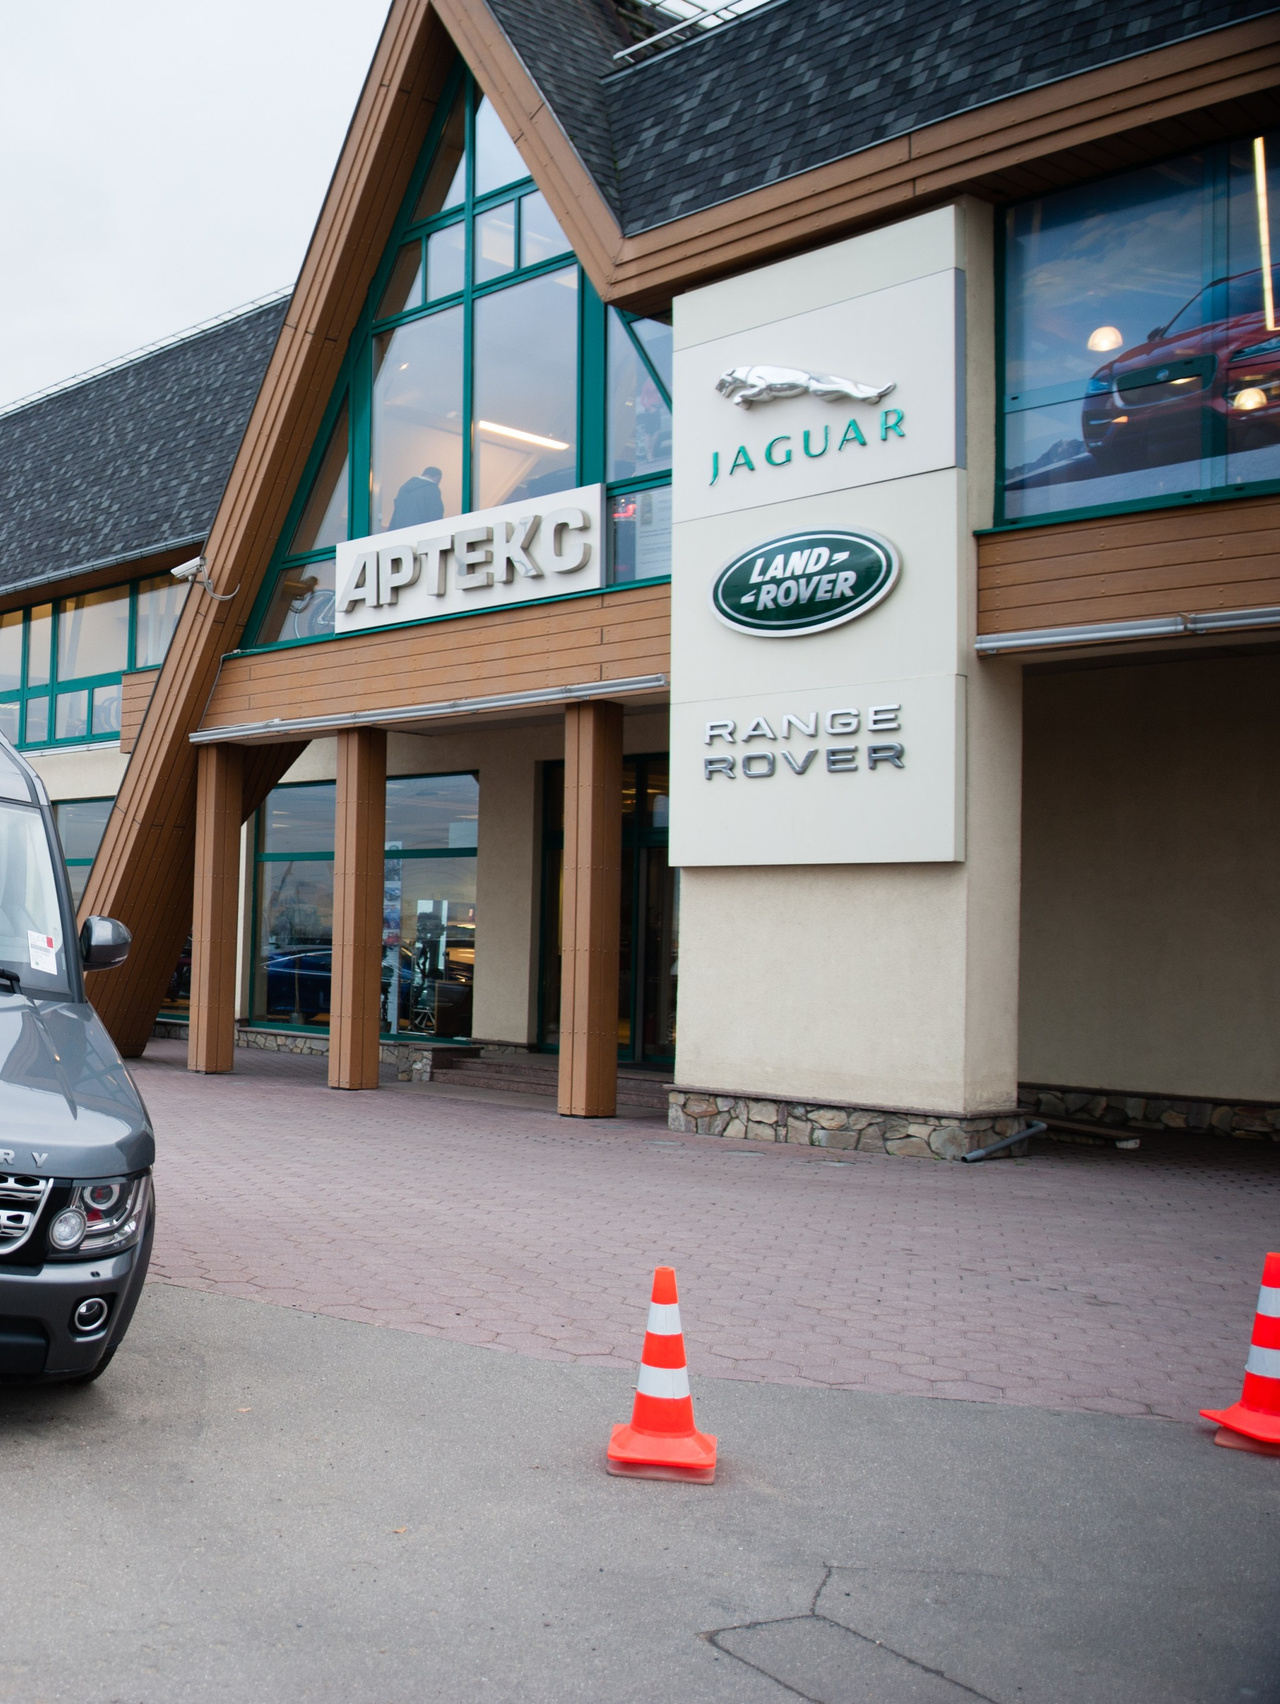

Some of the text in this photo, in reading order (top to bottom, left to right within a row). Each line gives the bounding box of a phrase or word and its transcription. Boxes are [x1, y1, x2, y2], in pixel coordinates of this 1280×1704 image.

[709, 408, 906, 486] JAGUAR
[336, 507, 592, 614] АРТЕКС
[749, 546, 831, 584] LAND
[756, 570, 857, 612] ROVER
[704, 703, 902, 746] RANGE
[704, 742, 906, 781] ROVER
